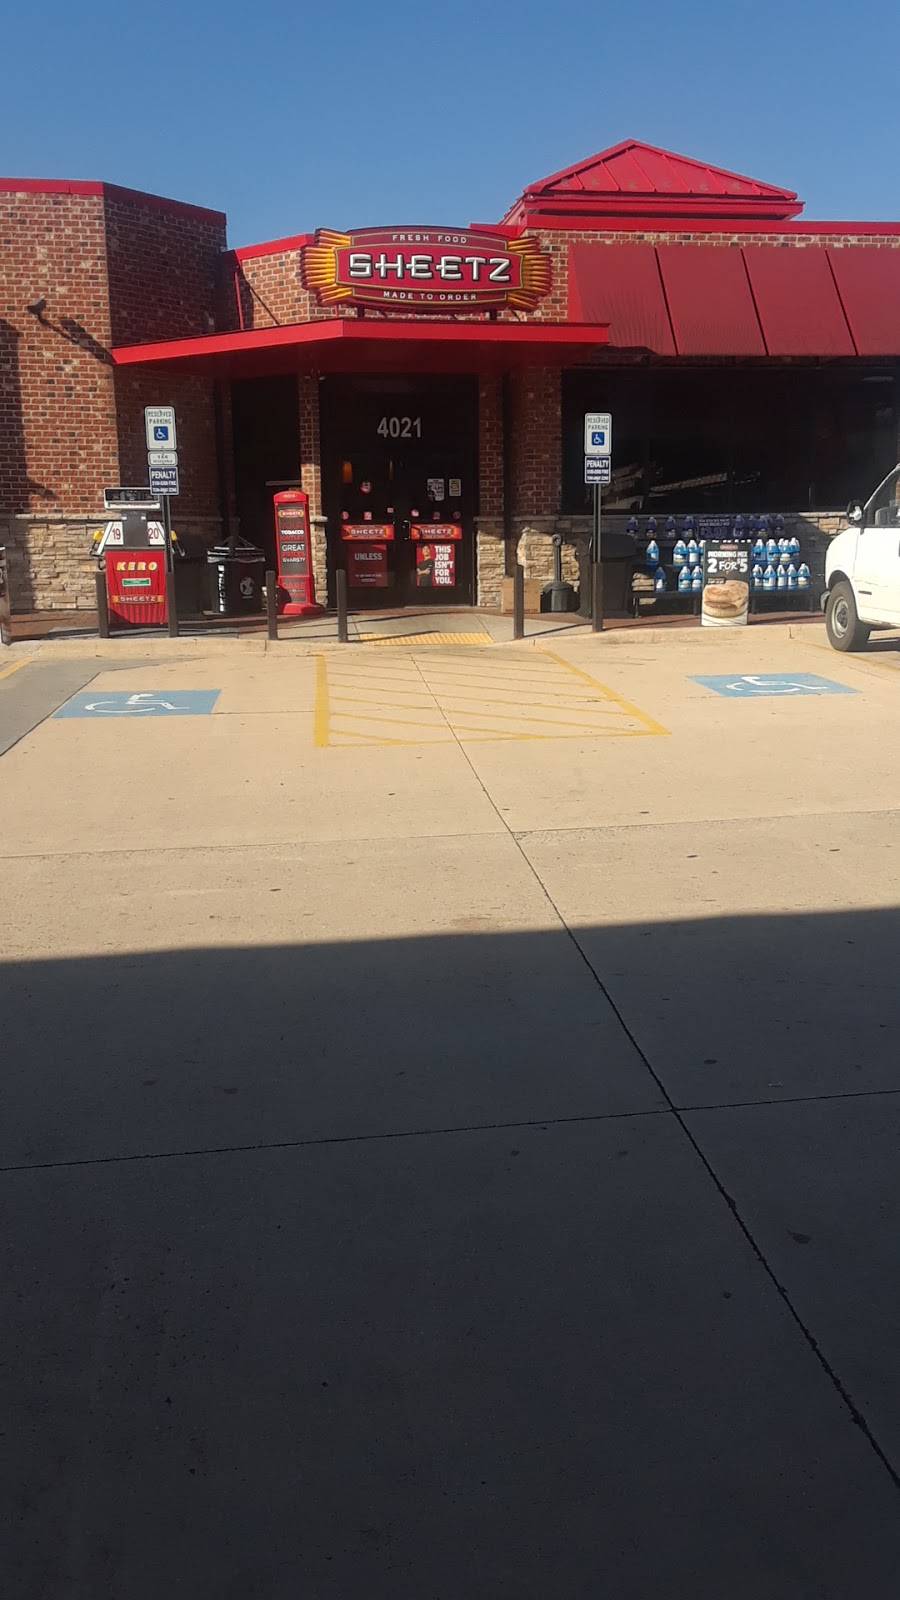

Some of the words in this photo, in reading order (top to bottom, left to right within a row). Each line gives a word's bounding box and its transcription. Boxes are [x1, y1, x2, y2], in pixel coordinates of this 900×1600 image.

[392, 234, 430, 242] FRESH
[437, 235, 468, 244] FOOD
[349, 253, 510, 282] SHEETZ
[383, 291, 414, 300] MADE
[420, 292, 434, 300] TO
[376, 416, 422, 438] 4021
[586, 459, 609, 468] PENALTY
[151, 470, 176, 479] PENALTY
[112, 528, 121, 540] 19
[147, 527, 159, 540] 20
[434, 545, 452, 554] THIS
[435, 553, 449, 561] JOB
[116, 562, 158, 571] KERO
[434, 561, 454, 569] ISN'T
[707, 558, 718, 573] 2
[719, 560, 738, 570] FOR
[434, 569, 450, 577] FOR
